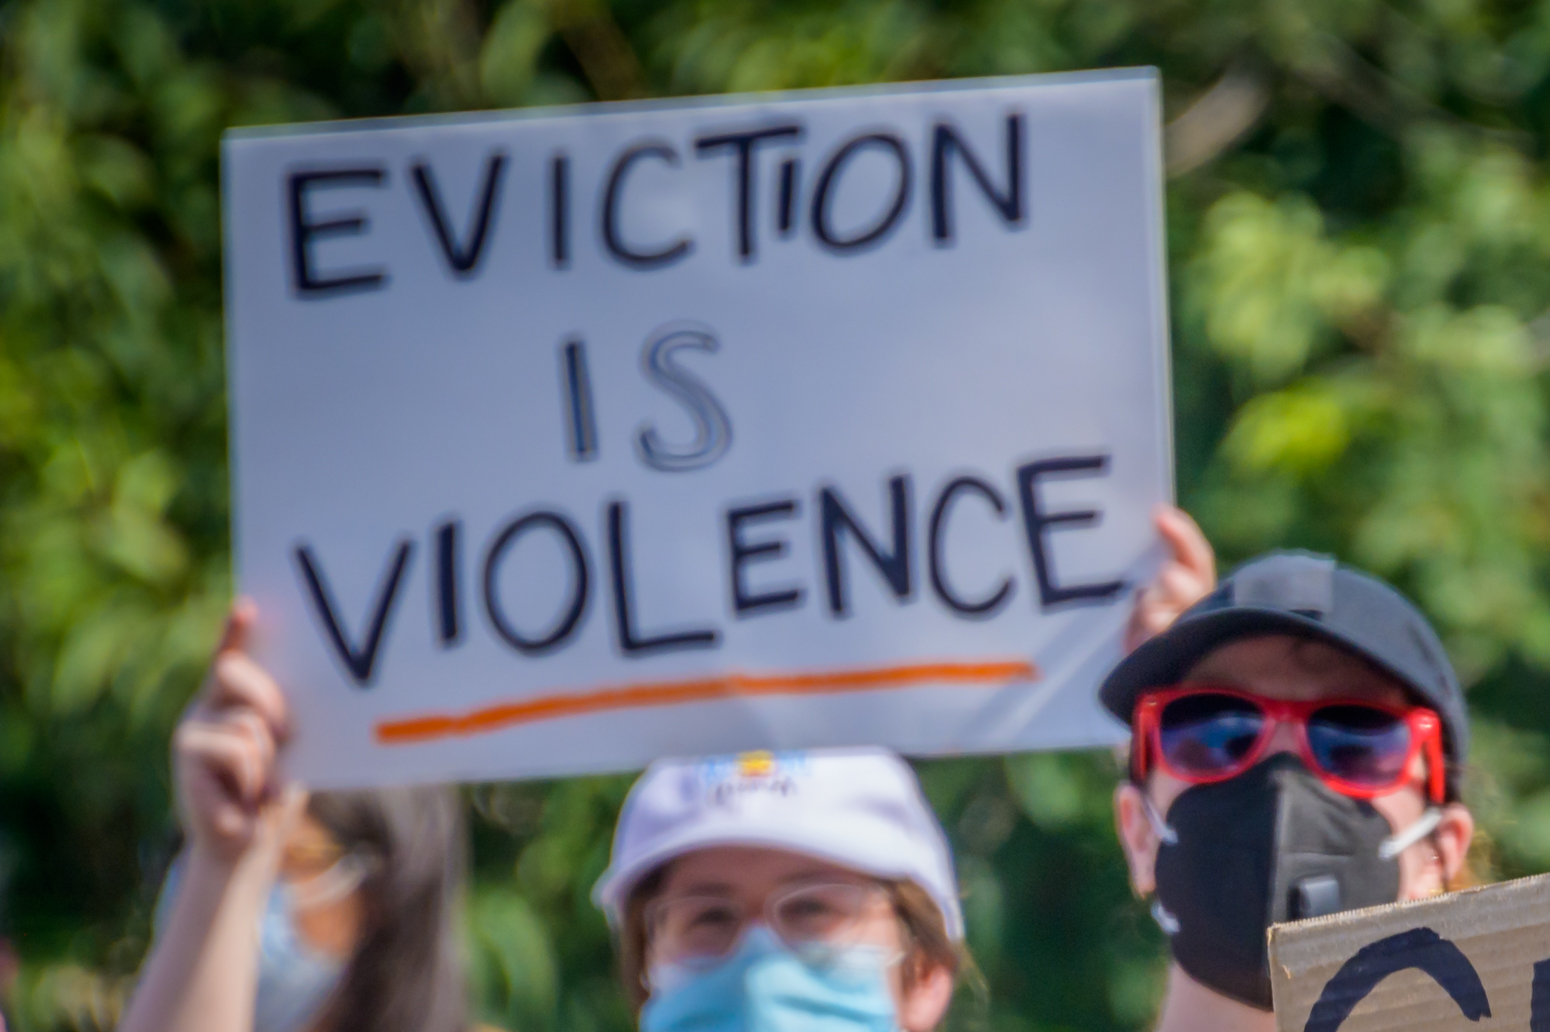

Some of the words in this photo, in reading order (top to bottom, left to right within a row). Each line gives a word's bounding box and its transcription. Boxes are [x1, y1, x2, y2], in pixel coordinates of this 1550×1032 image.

[284, 111, 1027, 299] EVICTION
[558, 320, 733, 472] IS
[293, 454, 1129, 690] VIOLENCE
